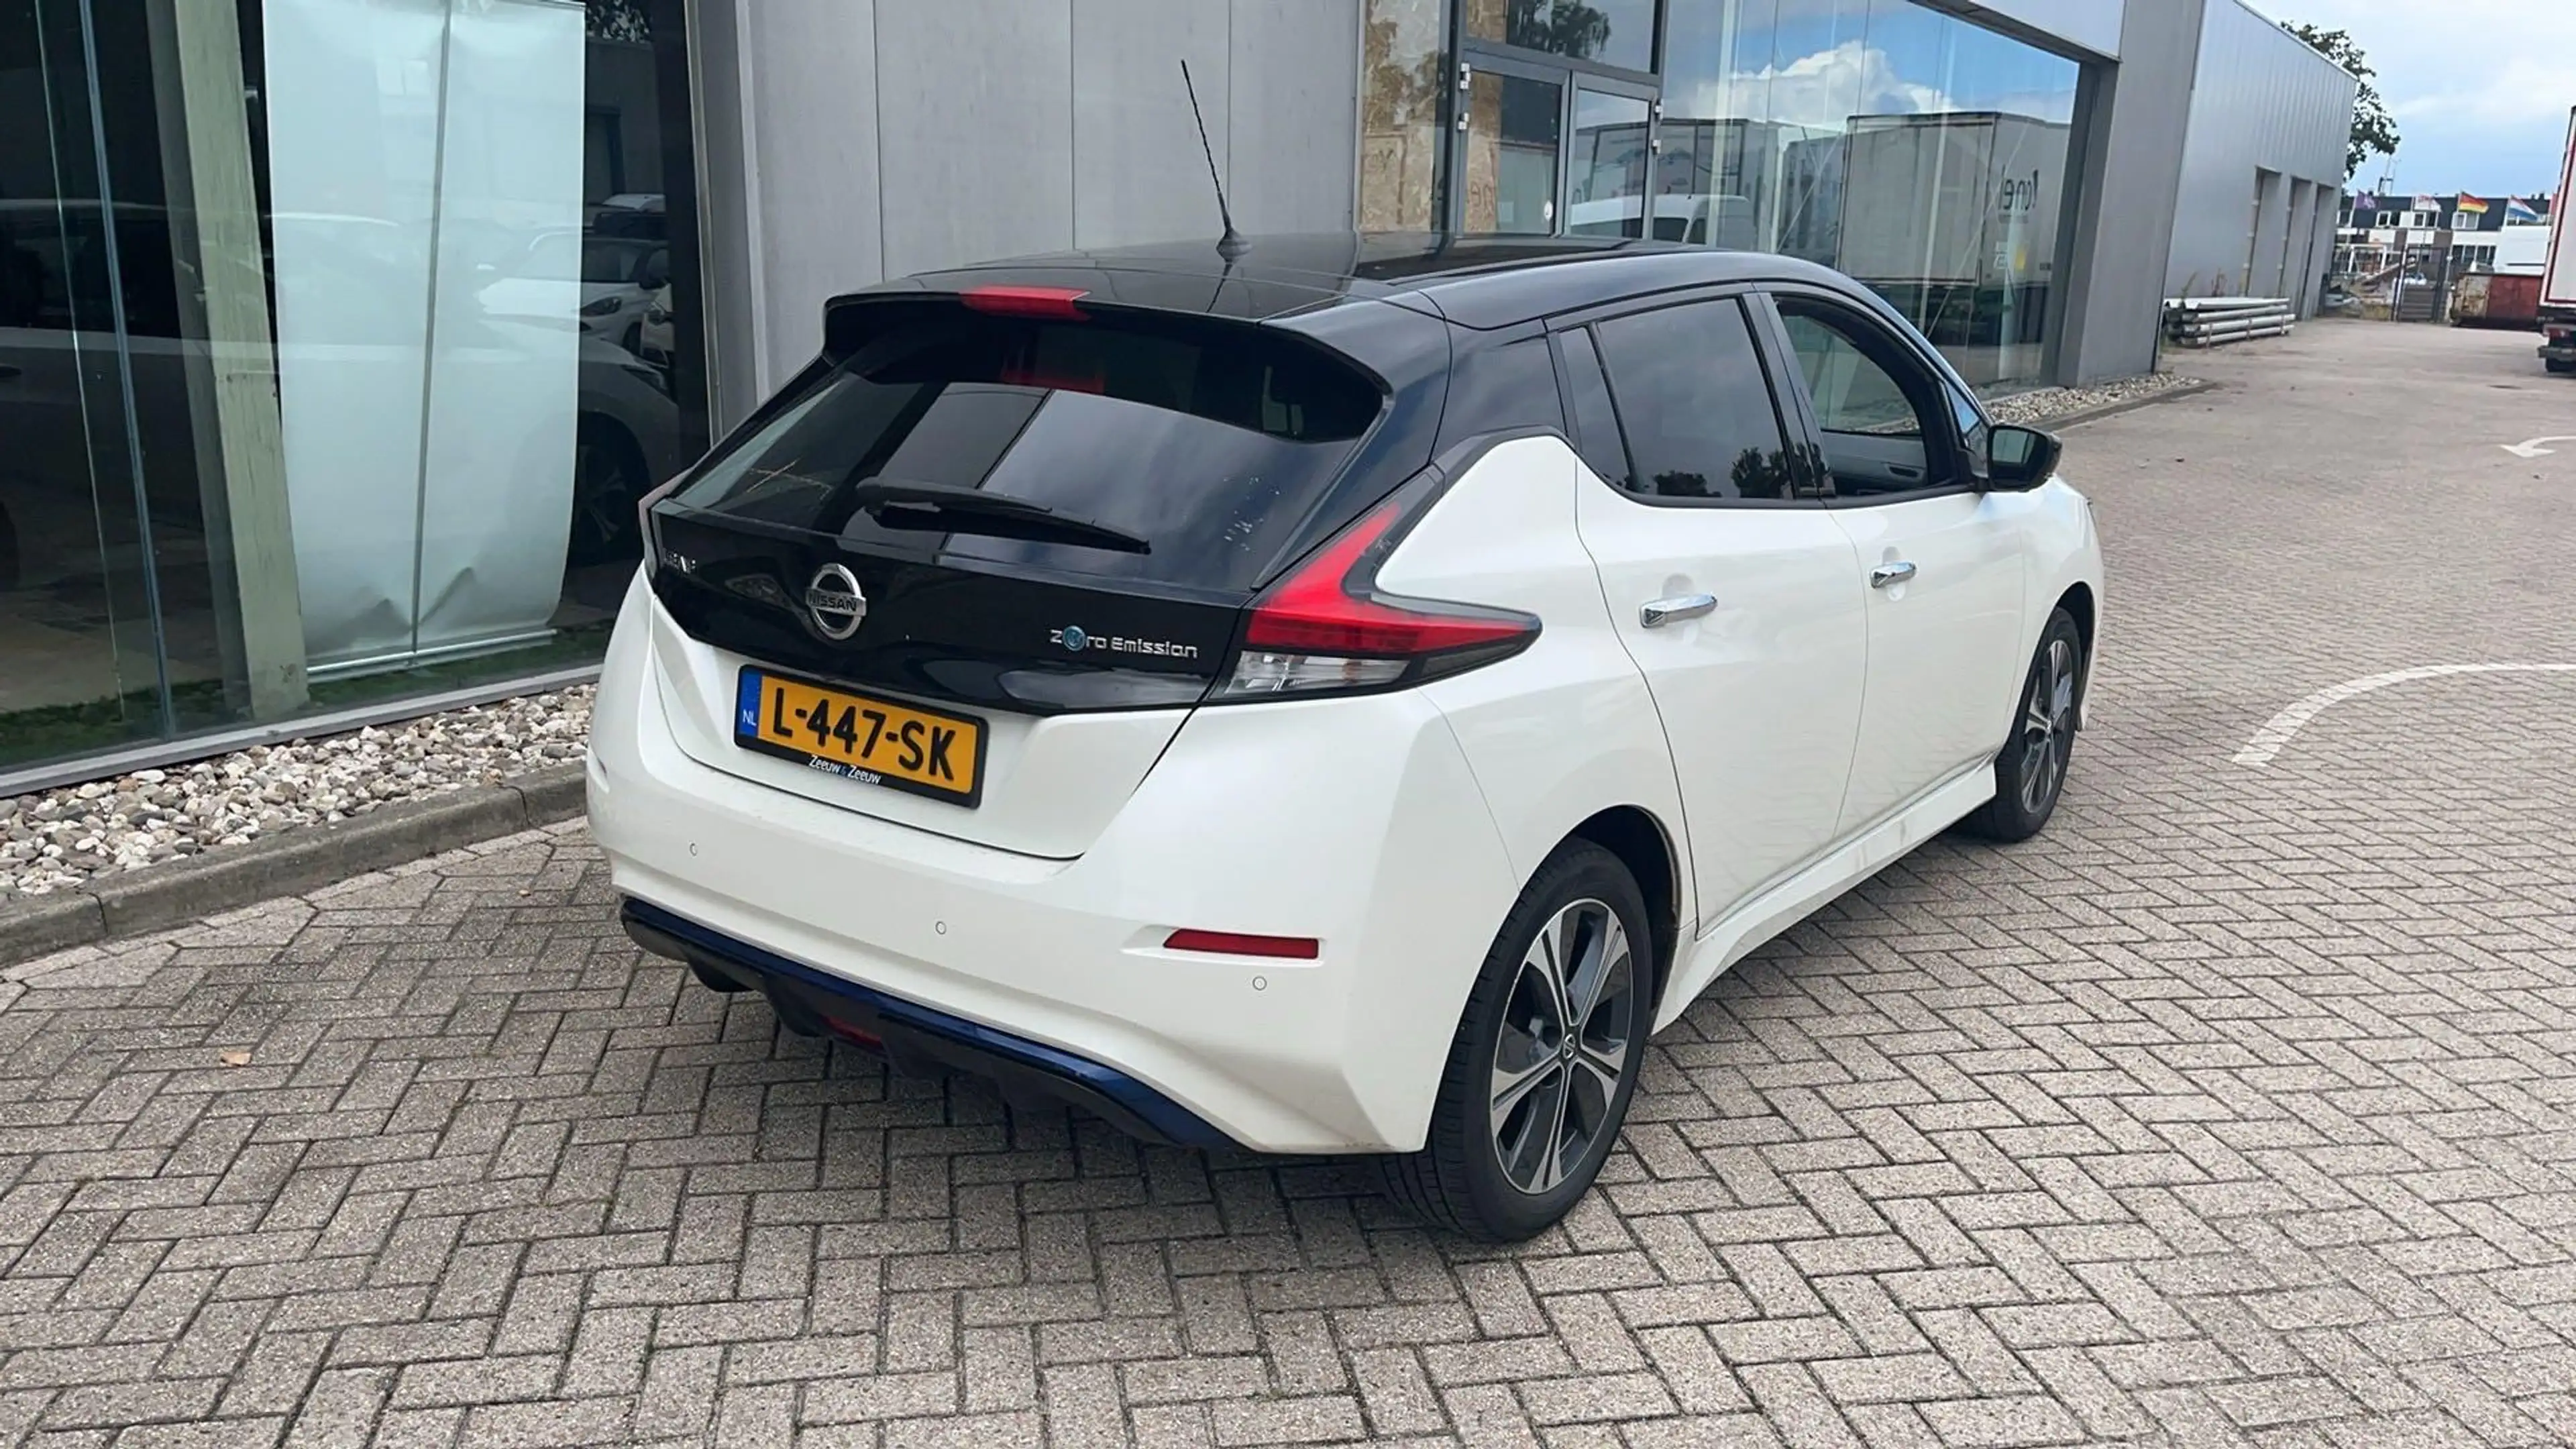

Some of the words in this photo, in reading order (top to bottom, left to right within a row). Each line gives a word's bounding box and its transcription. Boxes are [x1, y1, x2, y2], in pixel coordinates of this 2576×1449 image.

[808, 592, 857, 612] NISSAN
[1111, 637, 1198, 659] Emission
[743, 709, 757, 727] NL
[773, 687, 956, 782] L-447-SK
[809, 755, 841, 773] Zeeuw
[847, 765, 881, 784] Zeeuw
